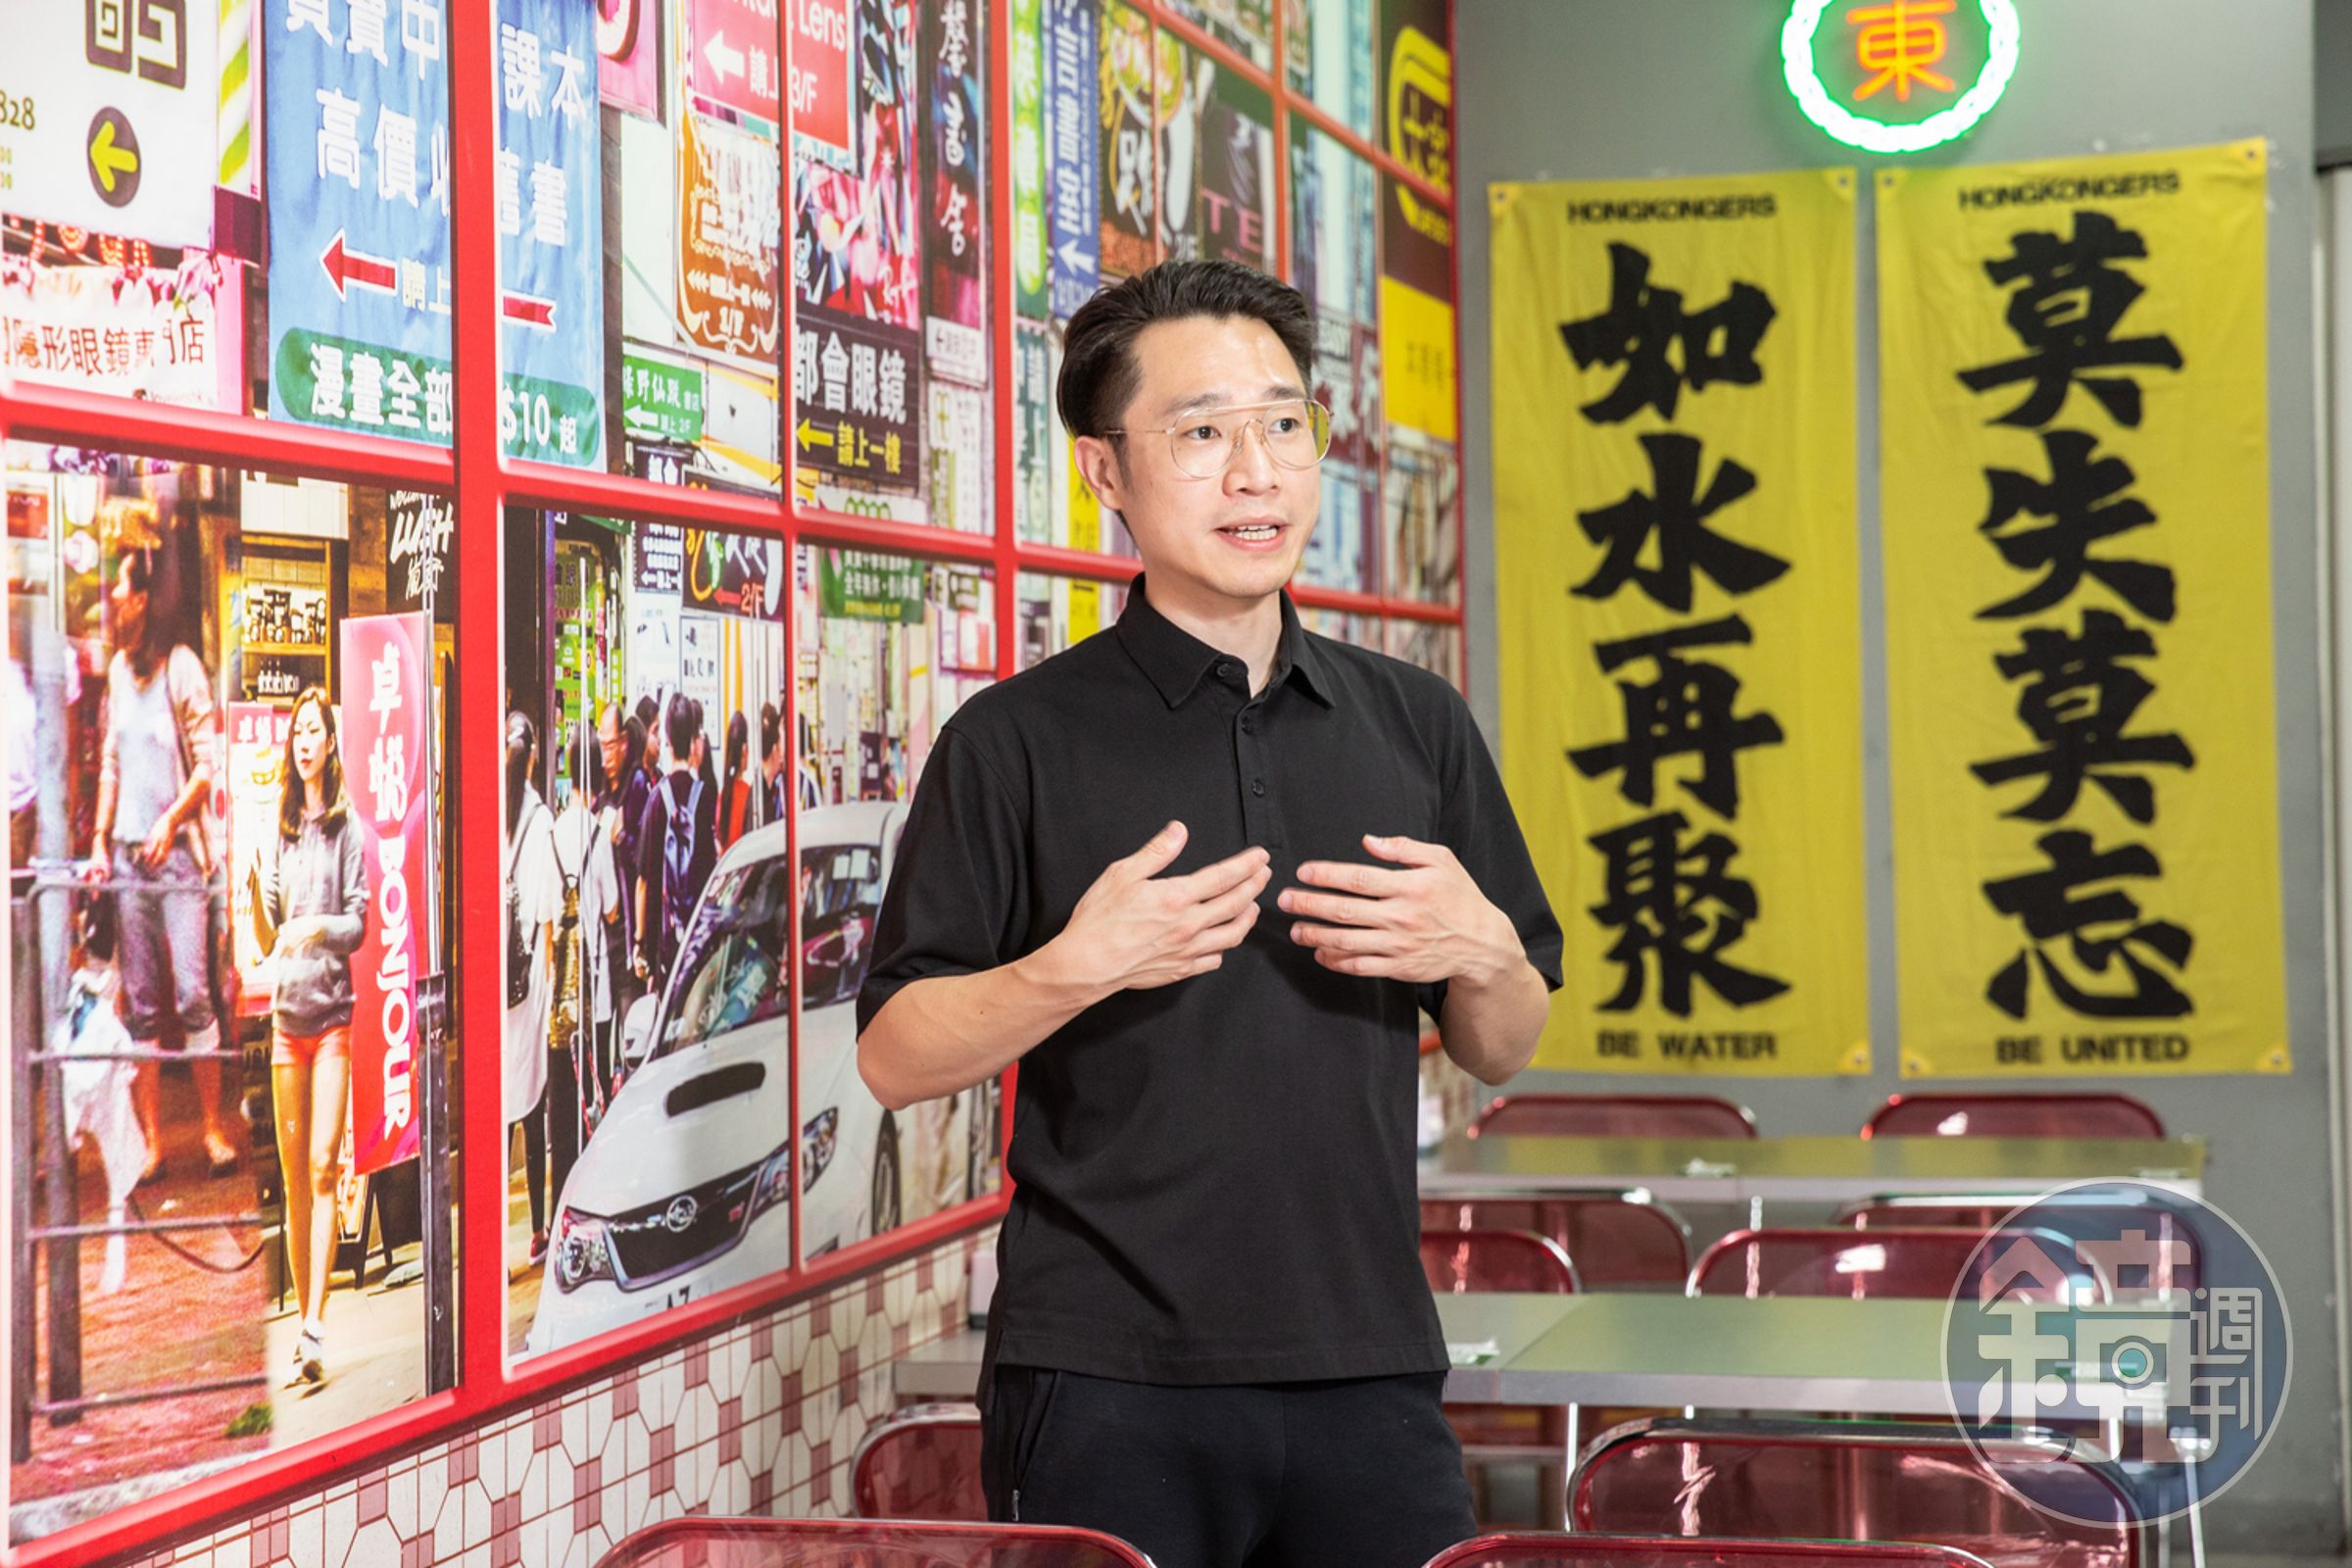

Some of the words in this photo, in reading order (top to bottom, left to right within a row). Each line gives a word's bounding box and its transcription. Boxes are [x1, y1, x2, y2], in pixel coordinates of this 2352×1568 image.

[501, 23, 586, 130] 課本
[1845, 0, 1957, 102] 東
[1567, 195, 1777, 224] HONGKONGERS
[1959, 172, 2180, 211] HONGKONGERS
[1556, 240, 1792, 1018] 如水再聚
[1956, 211, 2196, 1021] 莫失莫忘
[376, 834, 412, 1142] BONJOUR
[1597, 1029, 1640, 1059] BE
[1658, 1032, 1777, 1060] WATER
[1996, 1037, 2042, 1065] BE
[2062, 1035, 2190, 1063] UNITED
